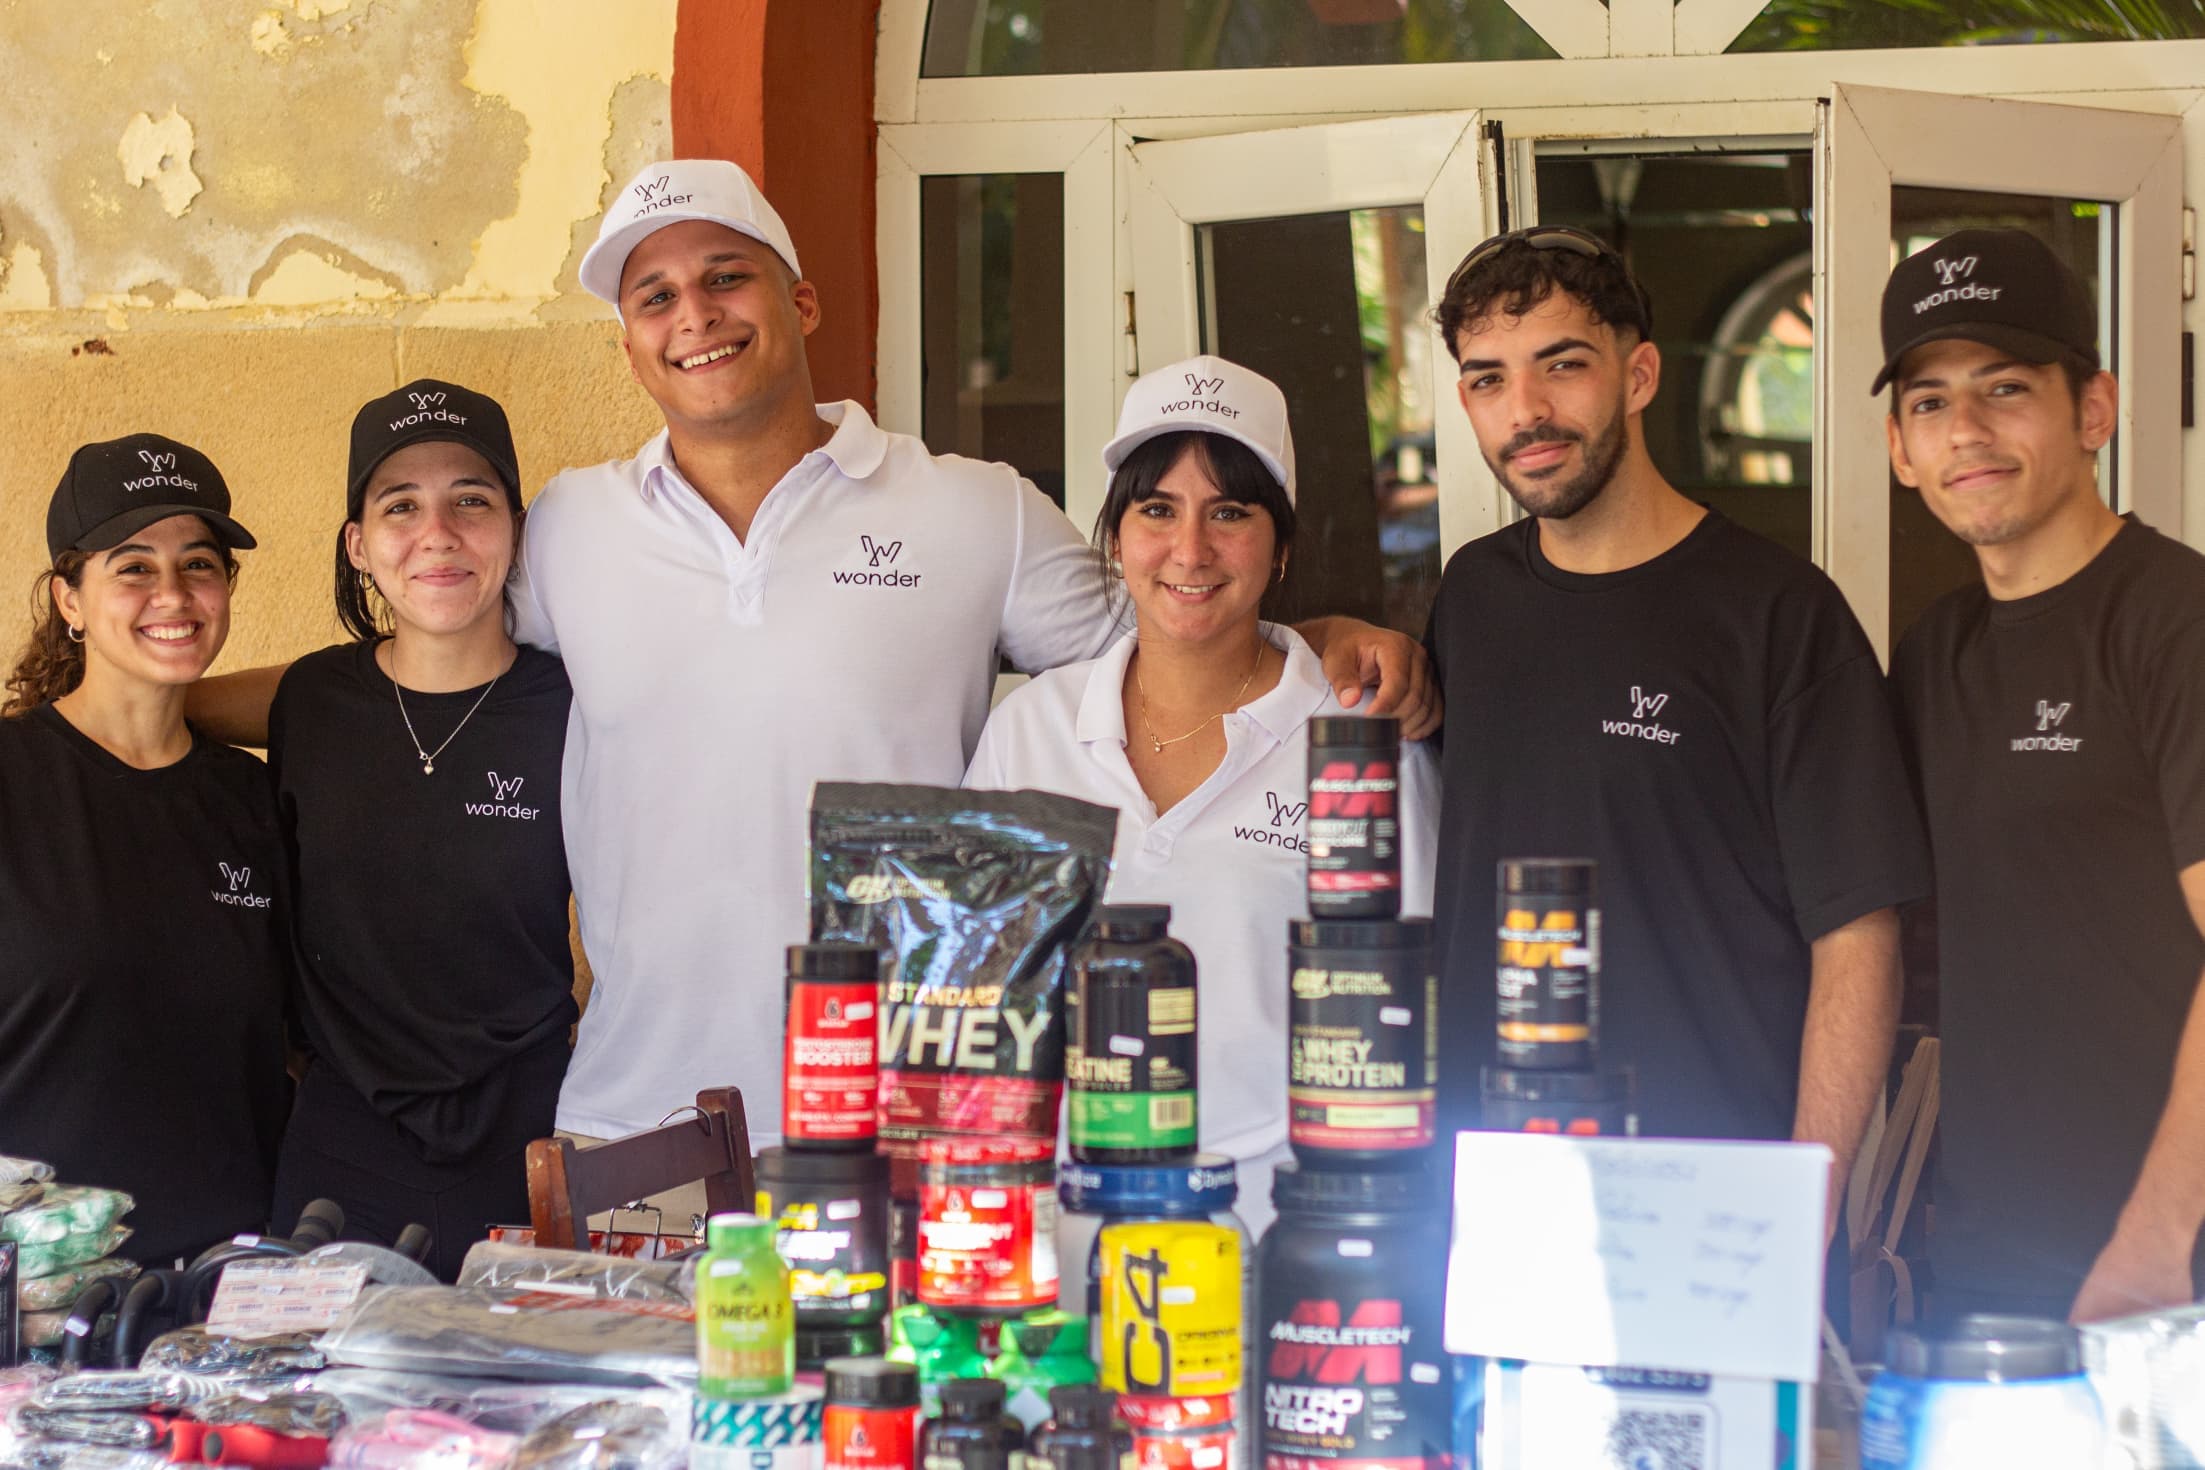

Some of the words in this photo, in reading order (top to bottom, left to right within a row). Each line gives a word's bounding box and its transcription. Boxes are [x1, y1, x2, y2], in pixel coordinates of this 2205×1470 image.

[1913, 284, 2001, 314] wonder
[389, 408, 467, 432] wonder
[1160, 399, 1240, 419] wonder
[123, 473, 198, 493] wonder
[833, 569, 922, 588] wonder
[1602, 719, 1681, 746] wonder
[2010, 733, 2083, 753] wonder
[465, 801, 541, 822] wonder
[1233, 825, 1310, 854] wonde
[211, 891, 271, 909] wonder
[1301, 1036, 1374, 1064] WHEY
[1301, 1062, 1406, 1088] PROTEIN
[1269, 1320, 1412, 1346] MUSCLETECH
[1264, 1382, 1364, 1416] NITRO
[1265, 1404, 1348, 1436] TECH
